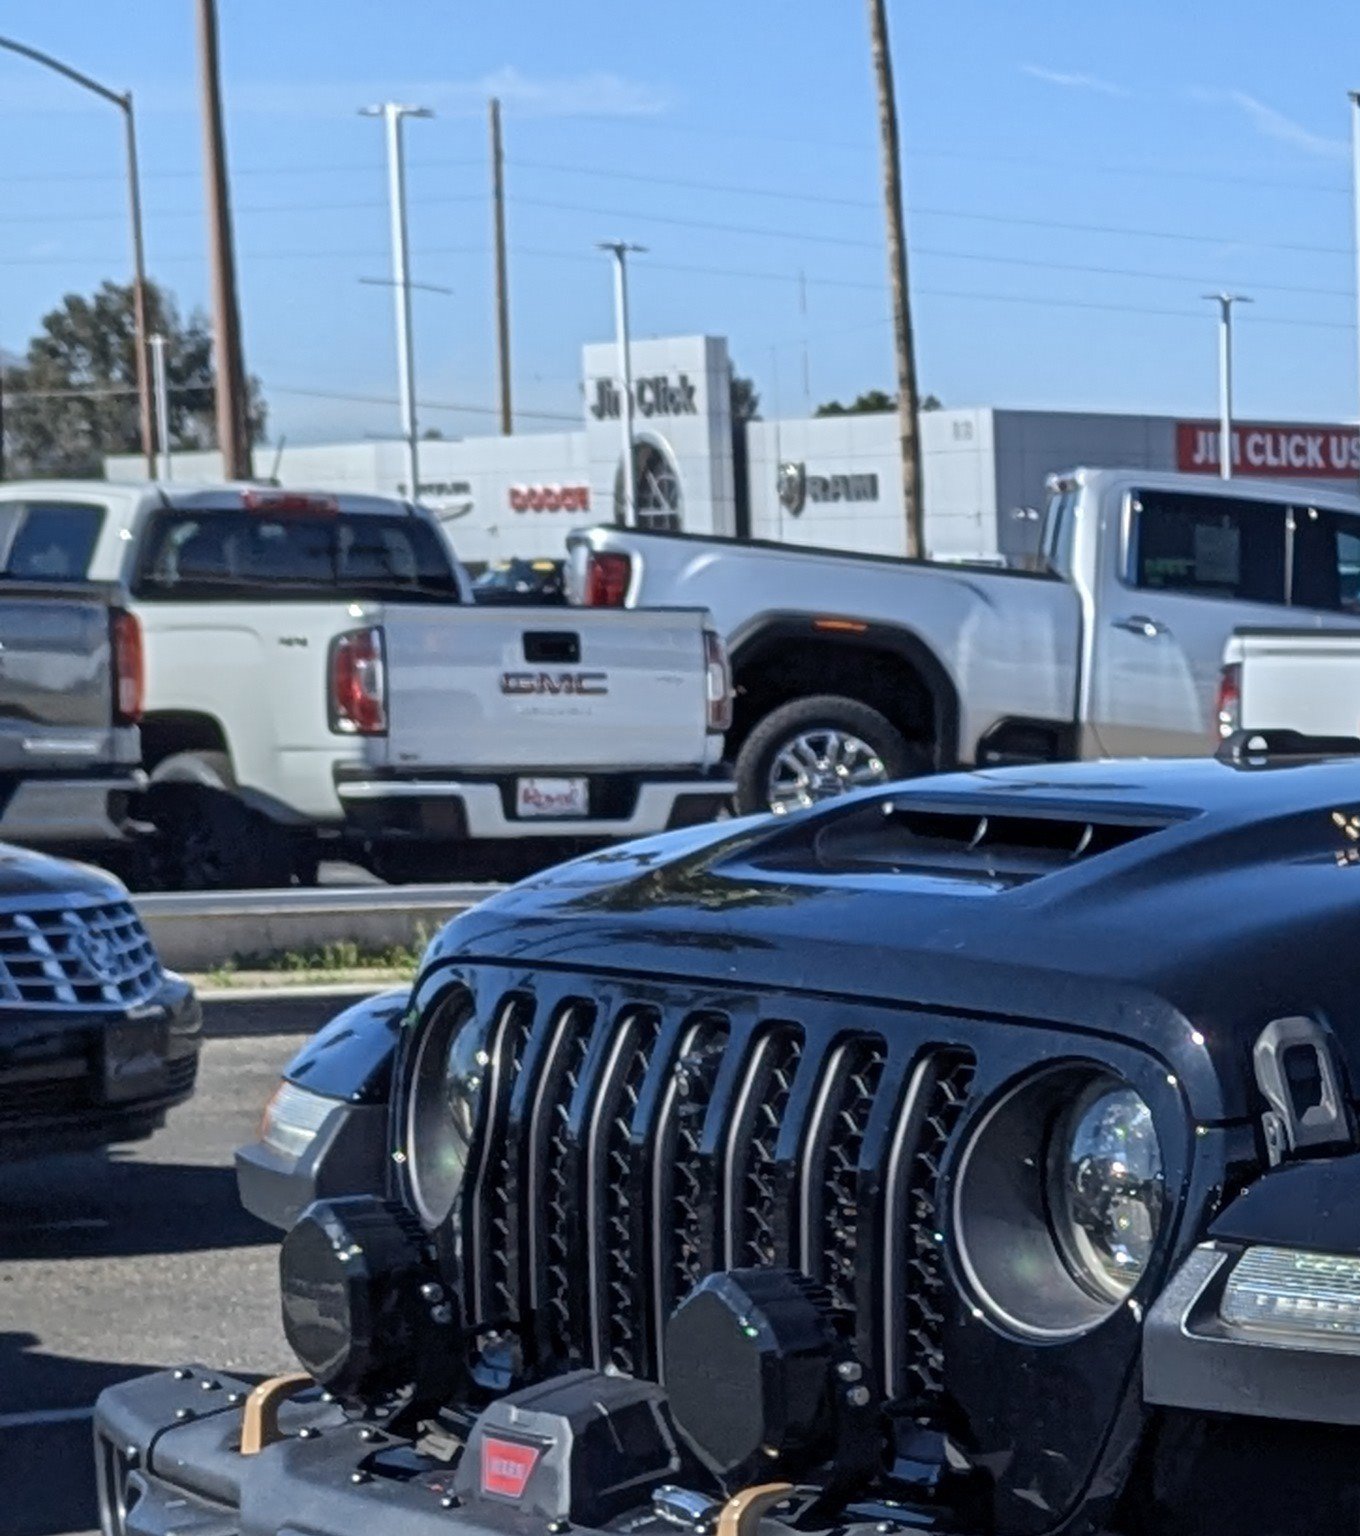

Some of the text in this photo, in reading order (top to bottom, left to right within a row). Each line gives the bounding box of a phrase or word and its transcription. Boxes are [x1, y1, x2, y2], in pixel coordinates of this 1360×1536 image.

[636, 374, 698, 418] Click
[1246, 431, 1325, 469] CLICK
[806, 473, 879, 502] RAM
[501, 672, 609, 694] GMC
